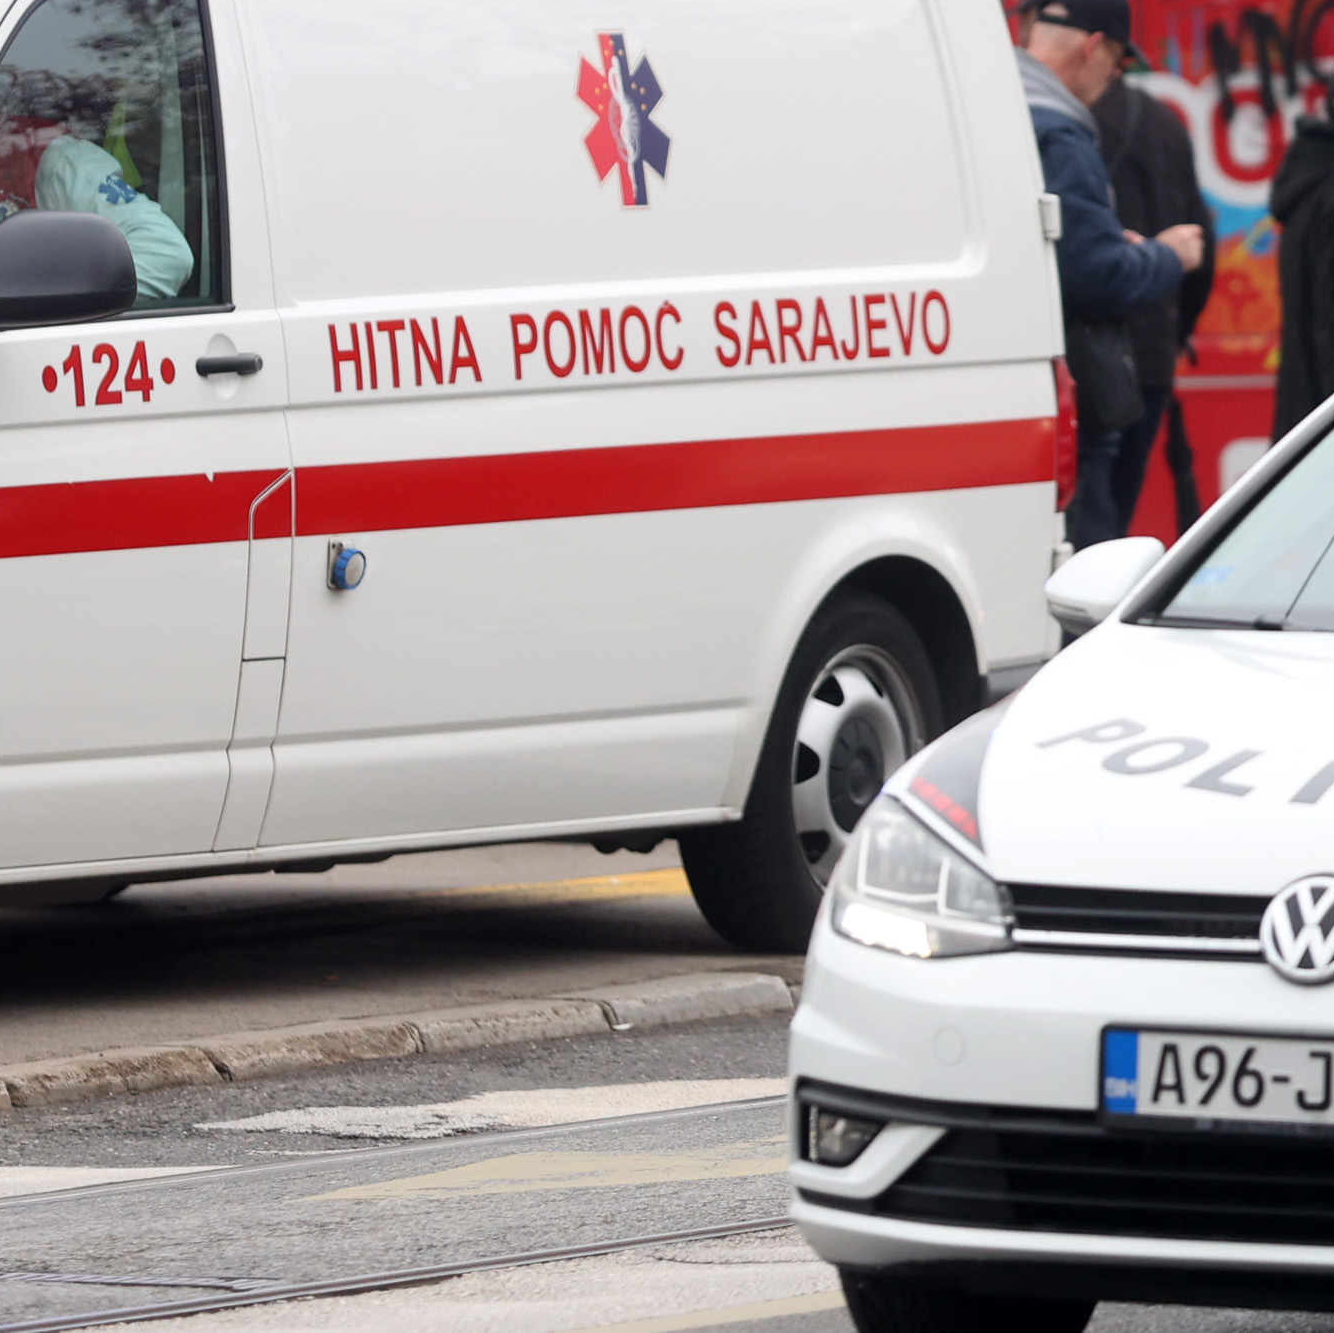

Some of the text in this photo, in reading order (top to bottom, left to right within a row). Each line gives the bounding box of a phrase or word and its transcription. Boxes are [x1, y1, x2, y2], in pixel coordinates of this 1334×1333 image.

[327, 289, 952, 393] HITNA POMOĆ SARAJEVO
